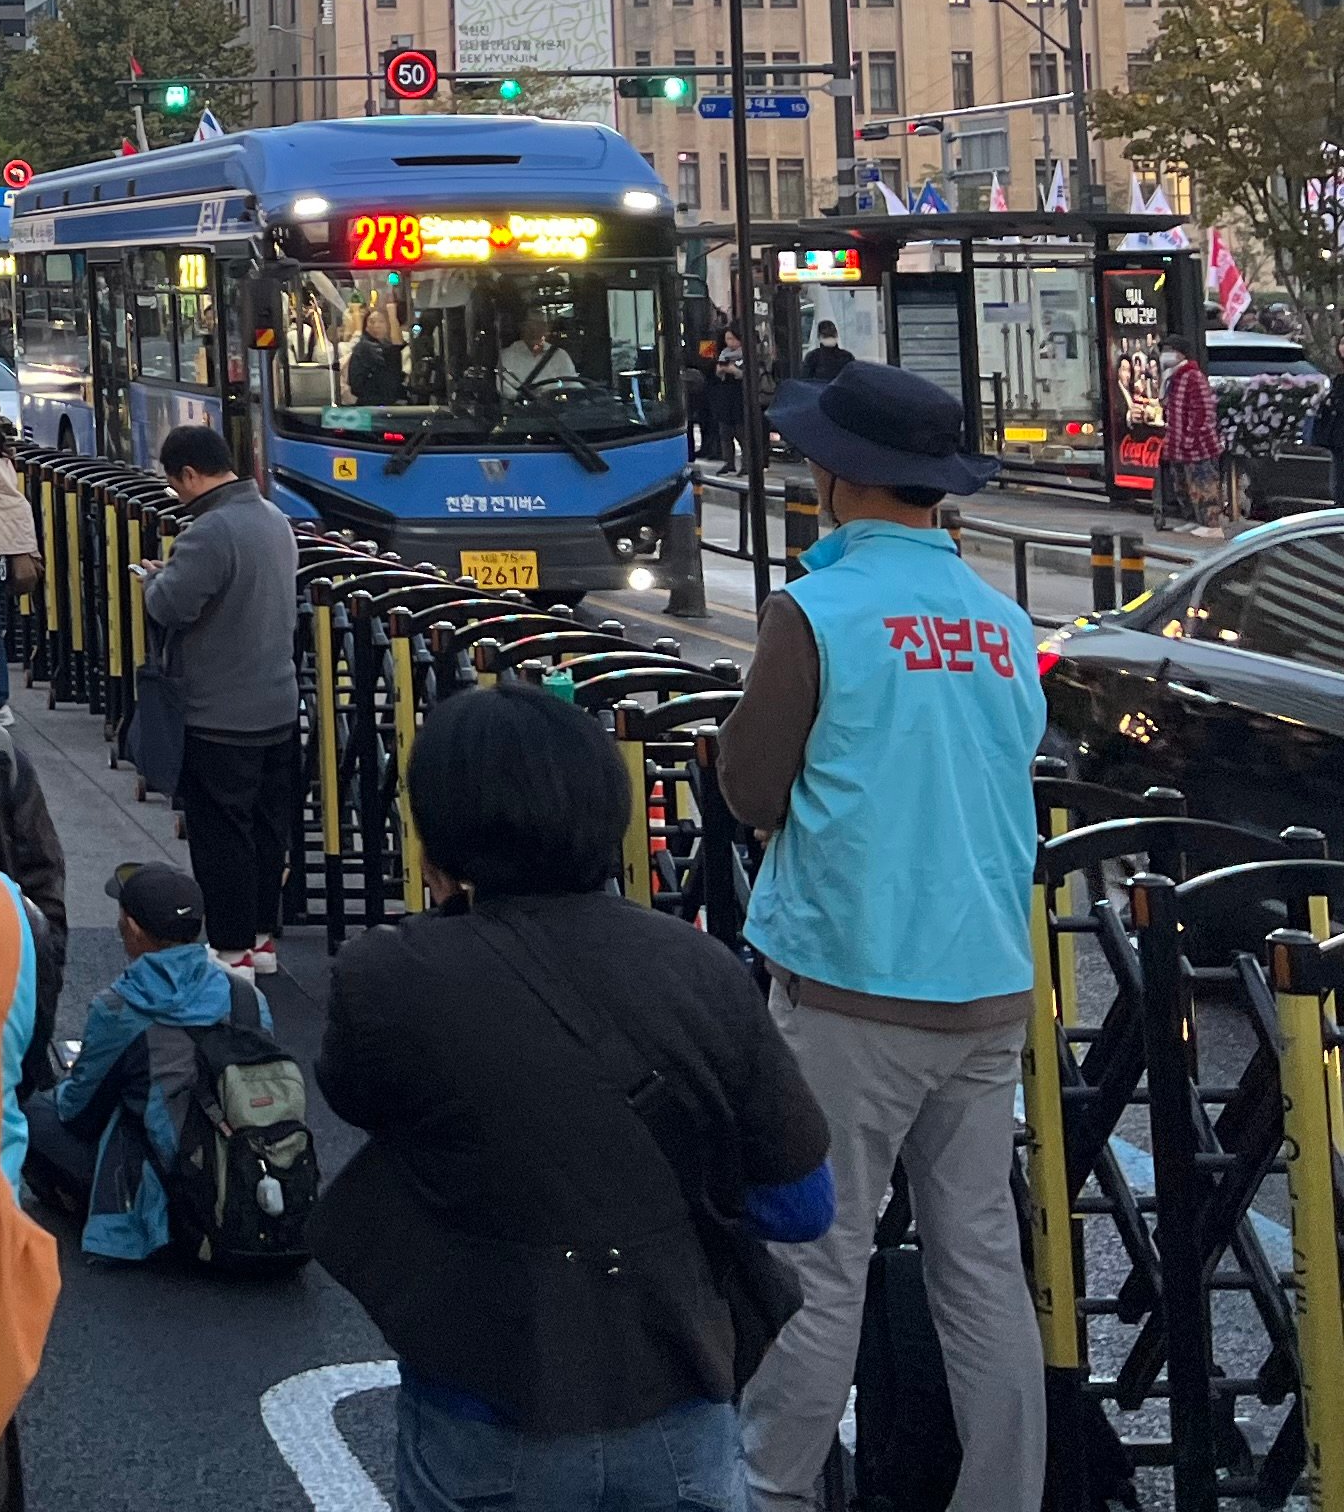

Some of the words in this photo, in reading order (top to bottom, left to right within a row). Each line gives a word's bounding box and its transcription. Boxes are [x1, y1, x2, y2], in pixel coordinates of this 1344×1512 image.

[484, 53, 538, 64] HYUNJIN
[398, 65, 425, 85] 50
[701, 103, 717, 113] 157
[197, 200, 226, 237] EV
[355, 216, 423, 261] 273
[445, 494, 488, 513] 친환경
[490, 495, 546, 512] 전기버스
[882, 615, 1015, 679] 진보당
